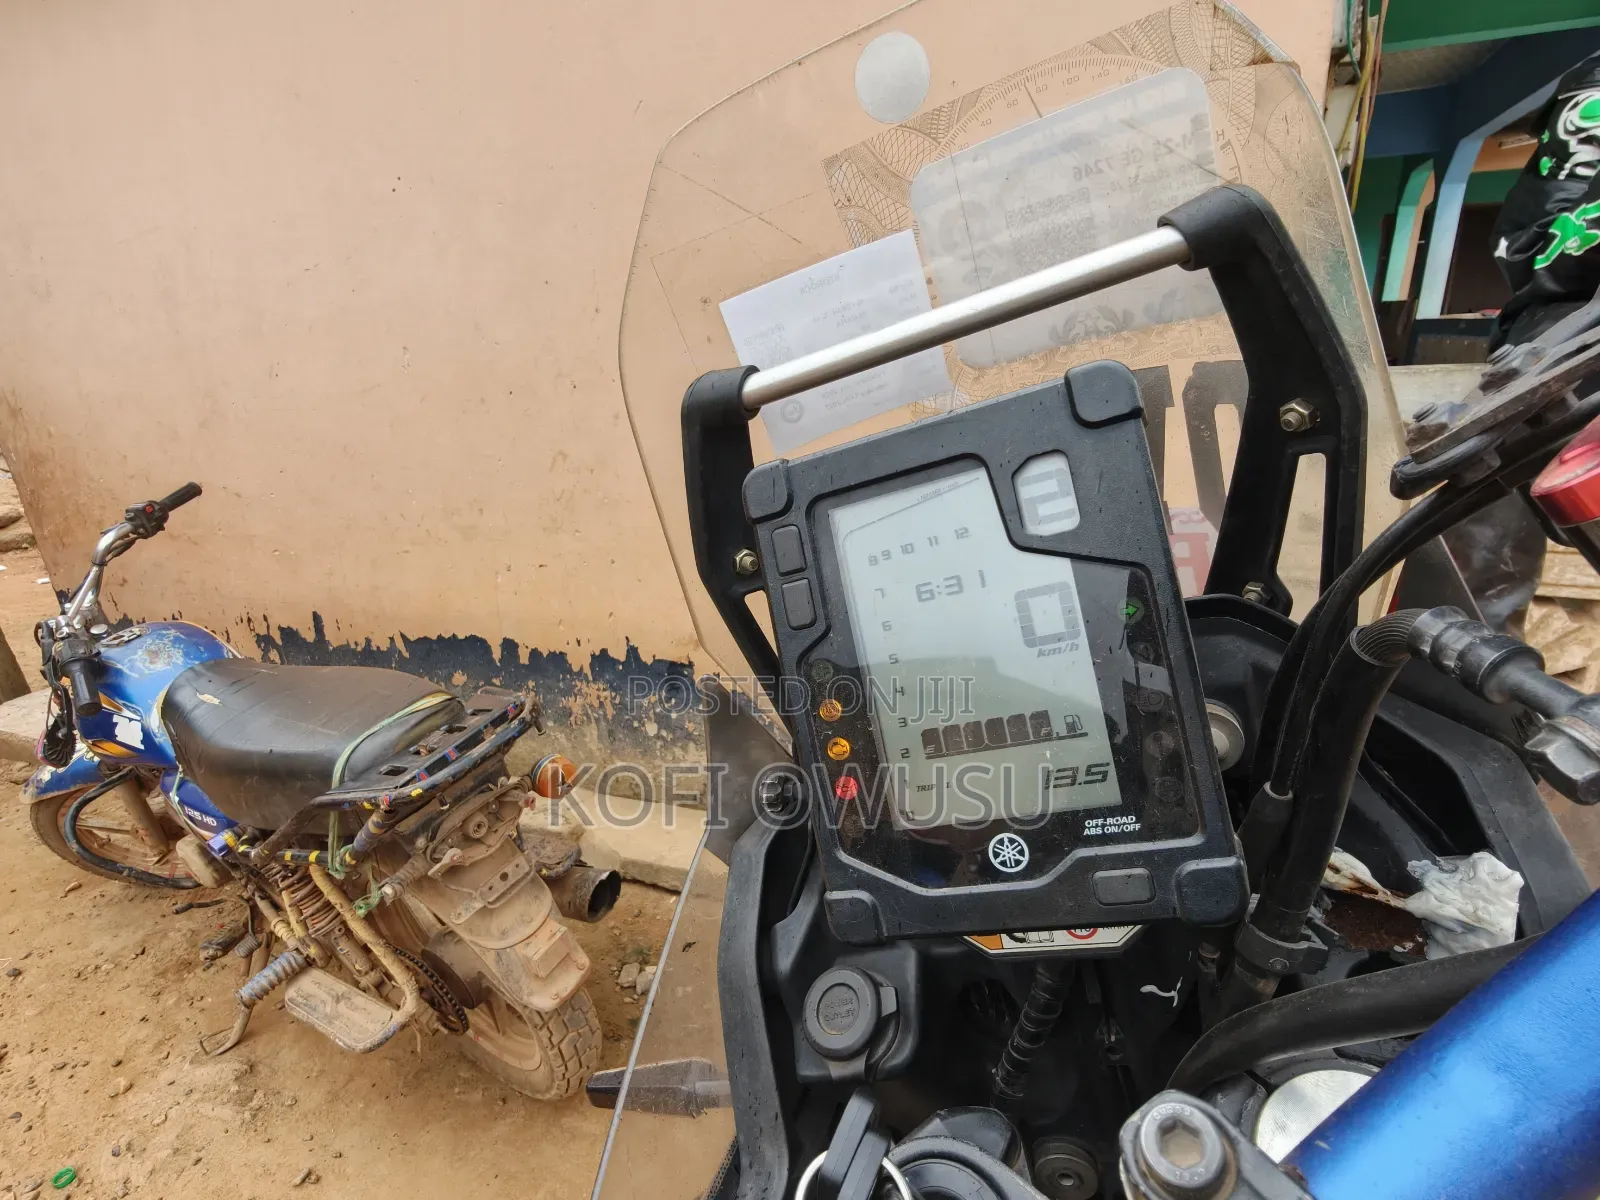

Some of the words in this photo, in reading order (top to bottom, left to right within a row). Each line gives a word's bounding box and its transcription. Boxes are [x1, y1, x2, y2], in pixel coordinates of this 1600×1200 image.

[1006, 98, 1019, 109] 60
[980, 117, 992, 128] 40
[954, 527, 971, 540] 12
[900, 542, 915, 555] 10
[927, 536, 940, 548] 11
[868, 553, 879, 566] 8
[881, 549, 893, 561] 9
[914, 569, 988, 604] 6:31
[874, 587, 886, 601] 7
[1014, 581, 1082, 649] 0
[882, 621, 893, 632] 6
[1036, 642, 1080, 659] km/h
[889, 654, 899, 665] 5
[895, 686, 905, 697] 4
[898, 718, 908, 729] 3
[900, 748, 910, 759] 2
[204, 814, 217, 827] HD
[1084, 814, 1136, 828] OFF-ROAD
[1083, 825, 1103, 836] ABS
[1104, 823, 1141, 835] ON/OFF
